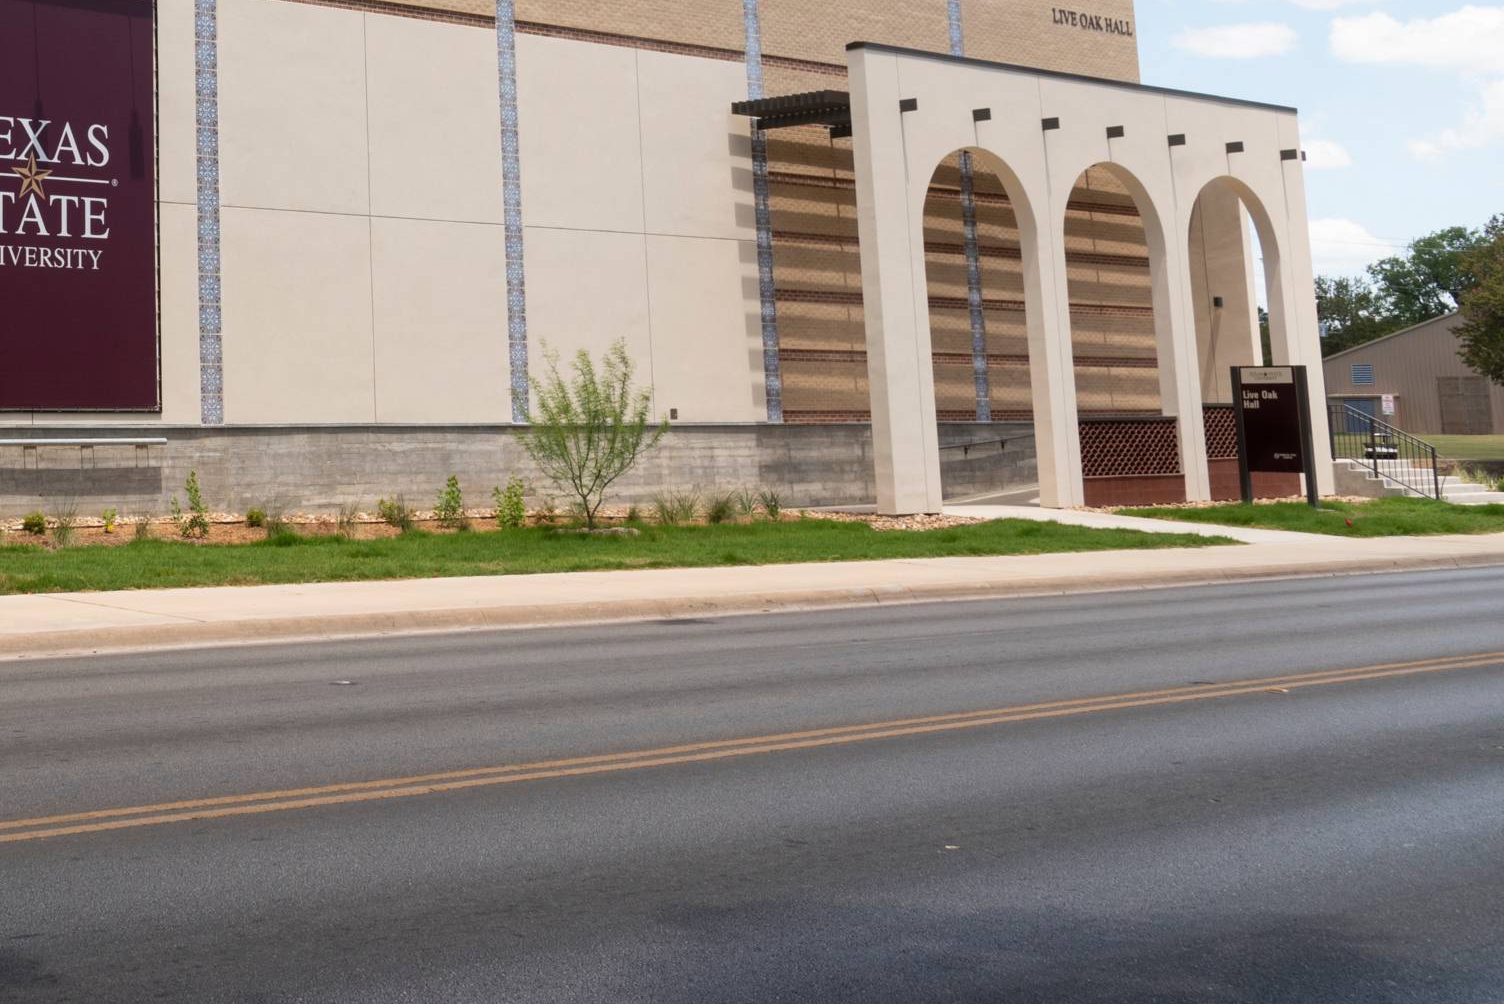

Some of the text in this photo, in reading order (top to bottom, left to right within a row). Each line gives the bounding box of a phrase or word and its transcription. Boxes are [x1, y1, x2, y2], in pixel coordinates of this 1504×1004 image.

[1052, 7, 1133, 36] LIVE OAK HALL
[1242, 390, 1278, 399] Live Oak
[1243, 399, 1260, 409] Hall
